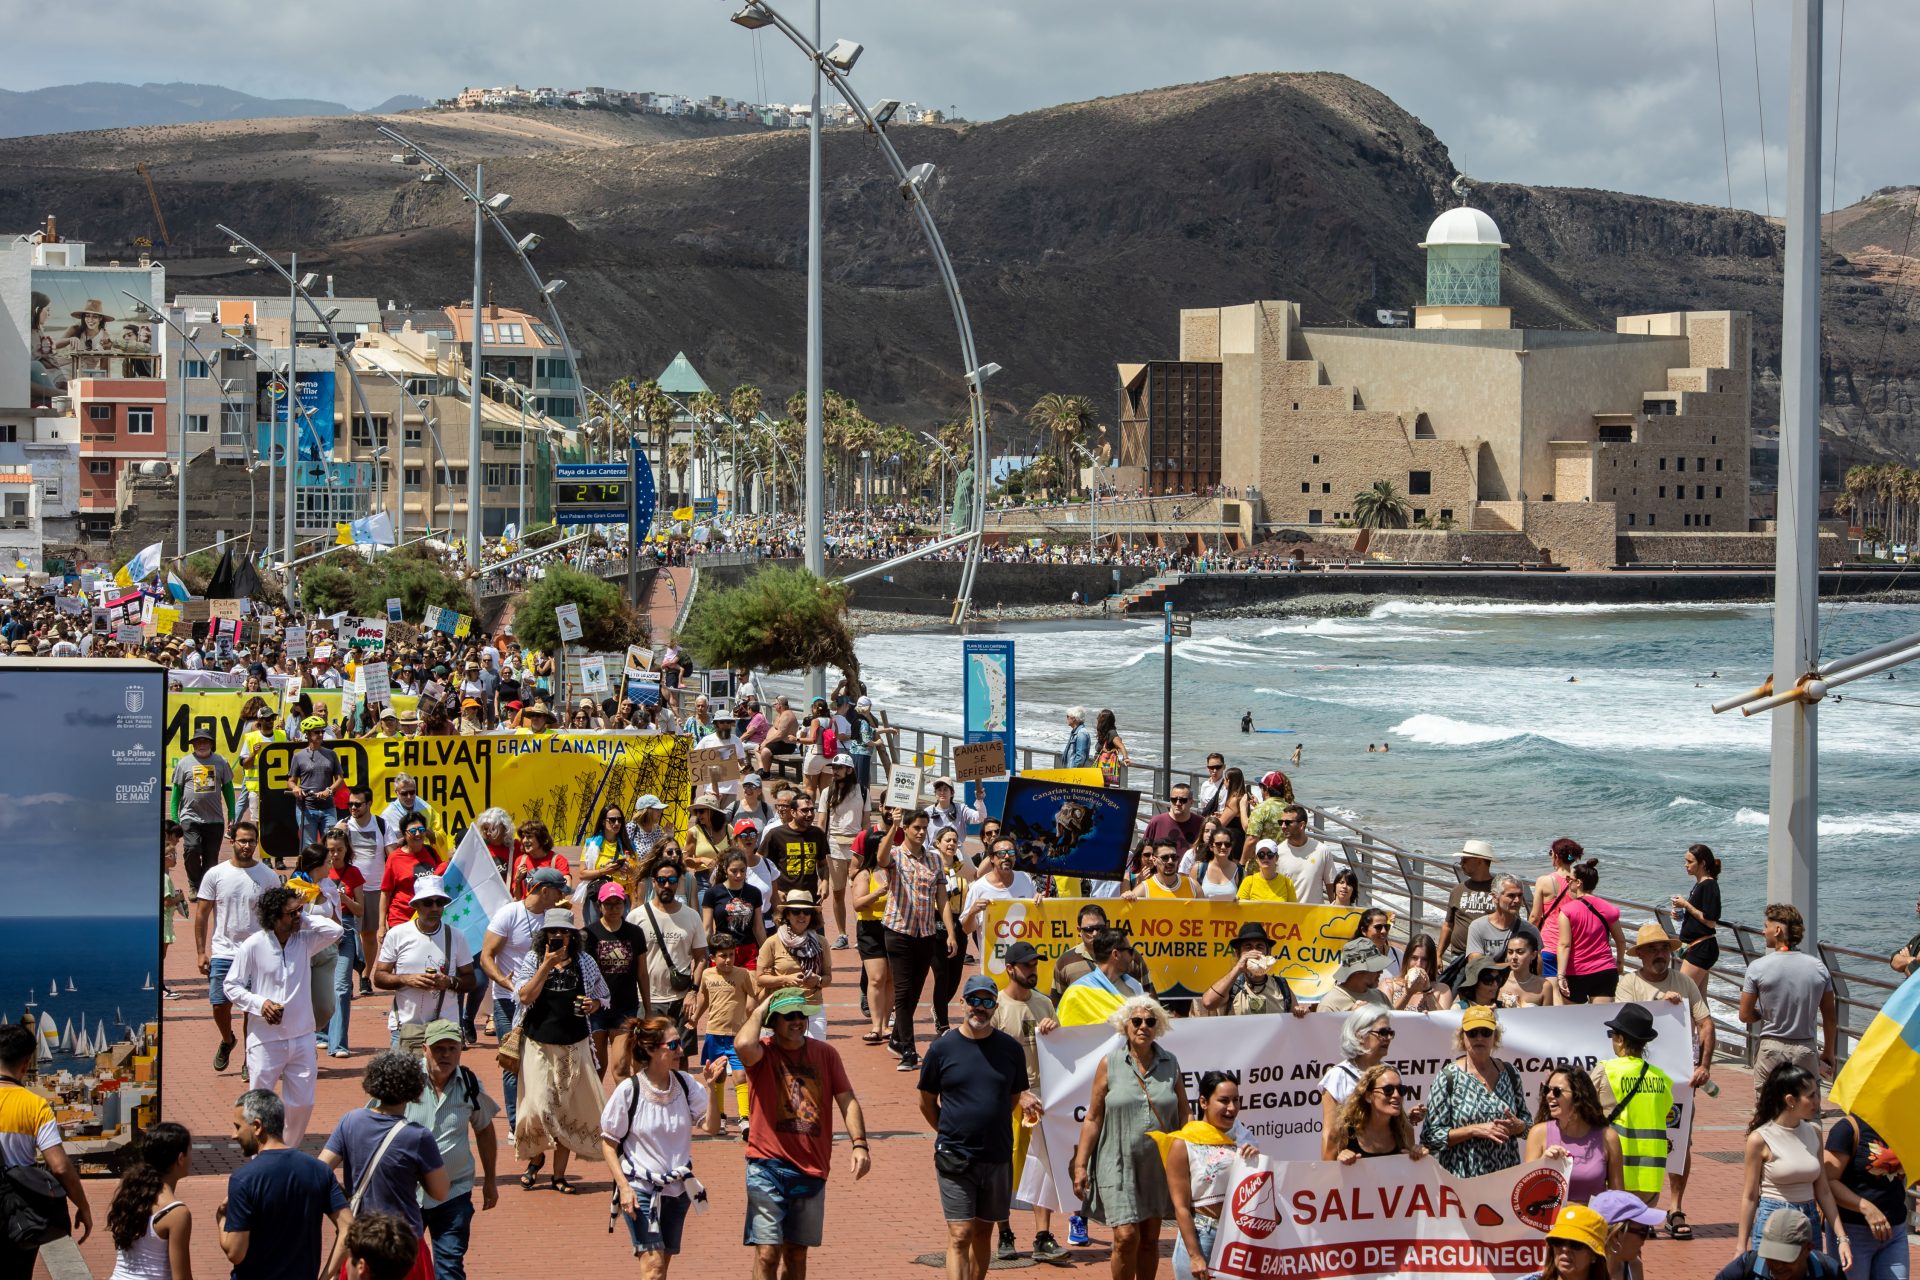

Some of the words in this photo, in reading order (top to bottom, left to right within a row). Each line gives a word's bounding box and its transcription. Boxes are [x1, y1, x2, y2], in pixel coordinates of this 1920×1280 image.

[497, 739, 541, 756] GRAN
[550, 737, 626, 758] CANARIA
[689, 749, 716, 763] ECO
[954, 743, 1002, 756] CANARIAS
[974, 755, 986, 763] SE
[958, 764, 1004, 779] DEFIENDE
[1033, 788, 1069, 801] Canarias,
[1071, 788, 1099, 797] nuestro
[1101, 794, 1120, 810] hogar
[1072, 794, 1103, 807] beneficio
[994, 920, 1044, 938] CON
[1051, 921, 1073, 938] EL
[1140, 919, 1173, 937] NO
[1179, 920, 1203, 937] SE
[1134, 942, 1207, 957] CUMBRE
[601, 958, 629, 966] adidas
[1248, 1065, 1284, 1083] 500
[1241, 1118, 1323, 1139] antiguado
[1238, 1176, 1264, 1206] Chira
[1514, 1183, 1524, 1204] LAGARTO
[1522, 1170, 1541, 1183] GIGANTE
[1551, 1171, 1563, 1182] GRAN
[1292, 1184, 1467, 1225] SALVAR
[1236, 1216, 1277, 1232] SALVAR
[1228, 1247, 1256, 1273] EL
[1261, 1248, 1357, 1276] BARRANCO
[1364, 1246, 1396, 1267] DE
[1404, 1245, 1546, 1266] ARGUINEGU
